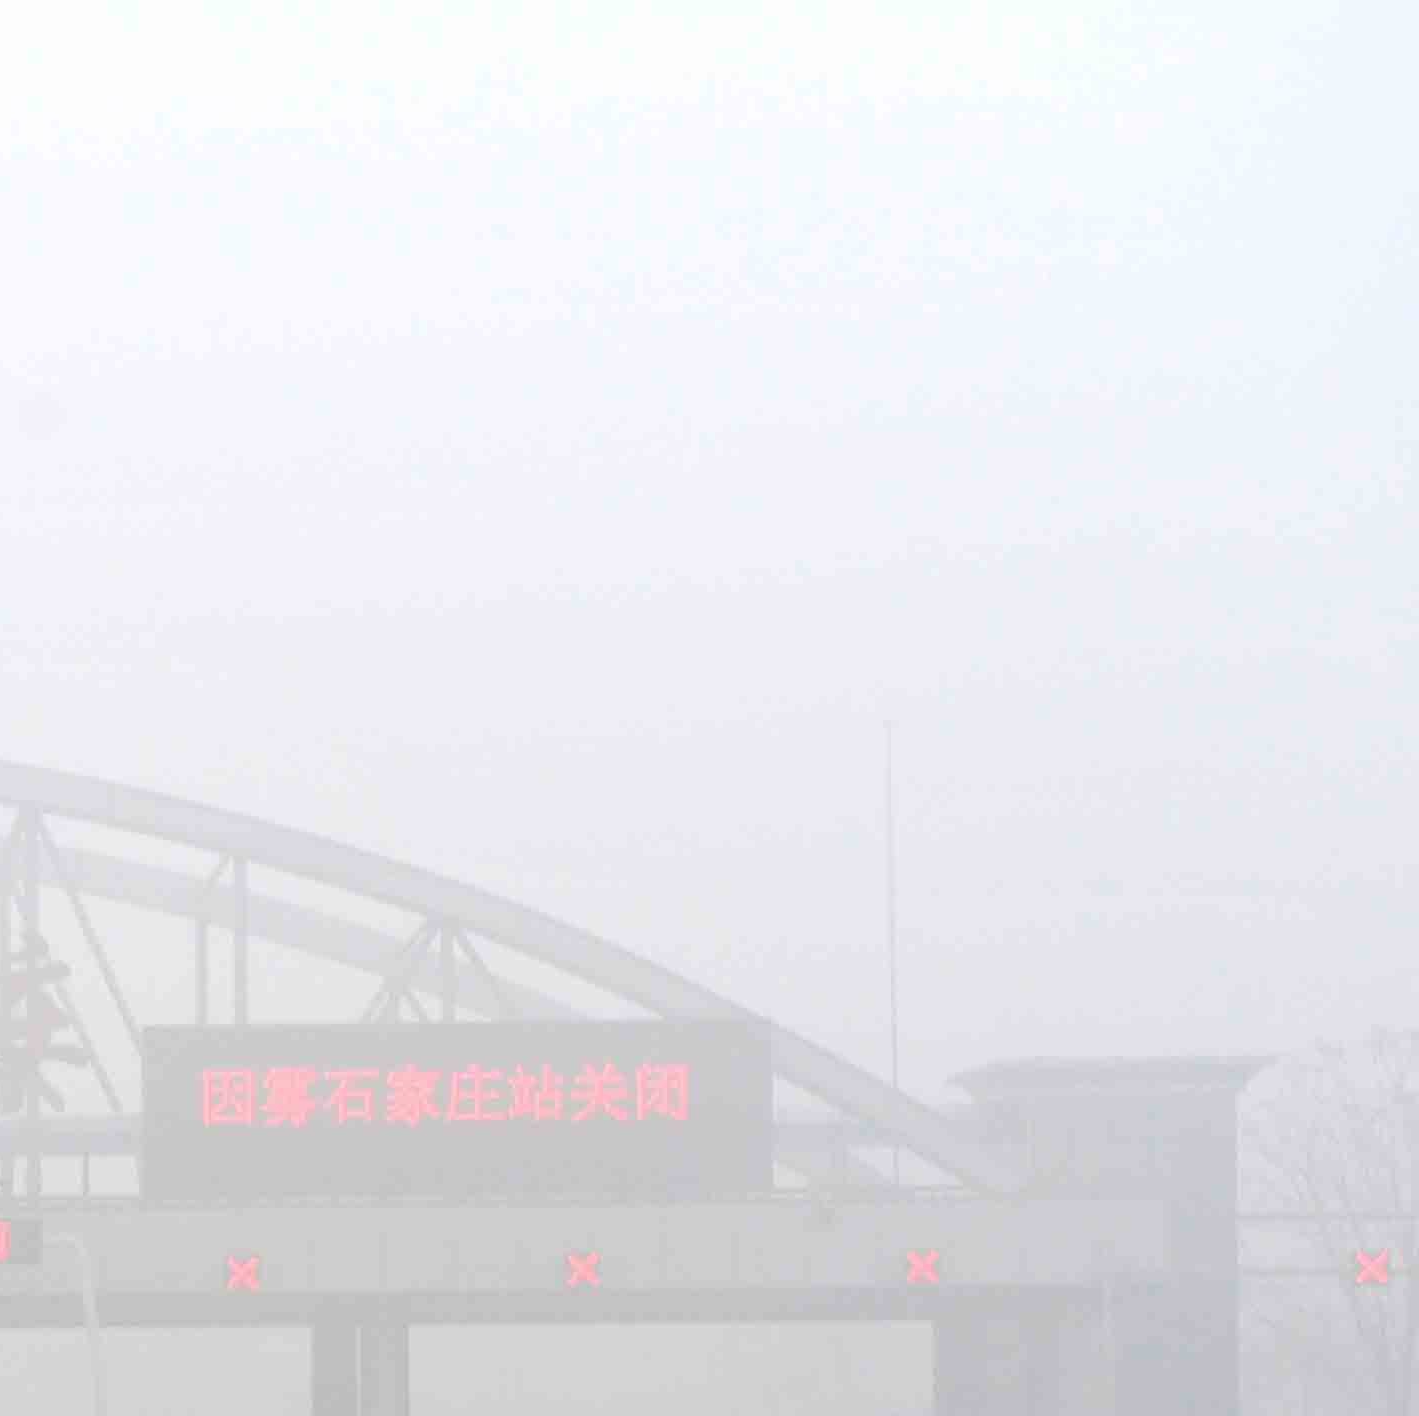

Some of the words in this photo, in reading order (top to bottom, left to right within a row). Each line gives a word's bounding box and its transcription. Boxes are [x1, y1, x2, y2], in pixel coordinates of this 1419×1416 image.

[201, 1062, 691, 1128] 因雾石家庄站关闭
